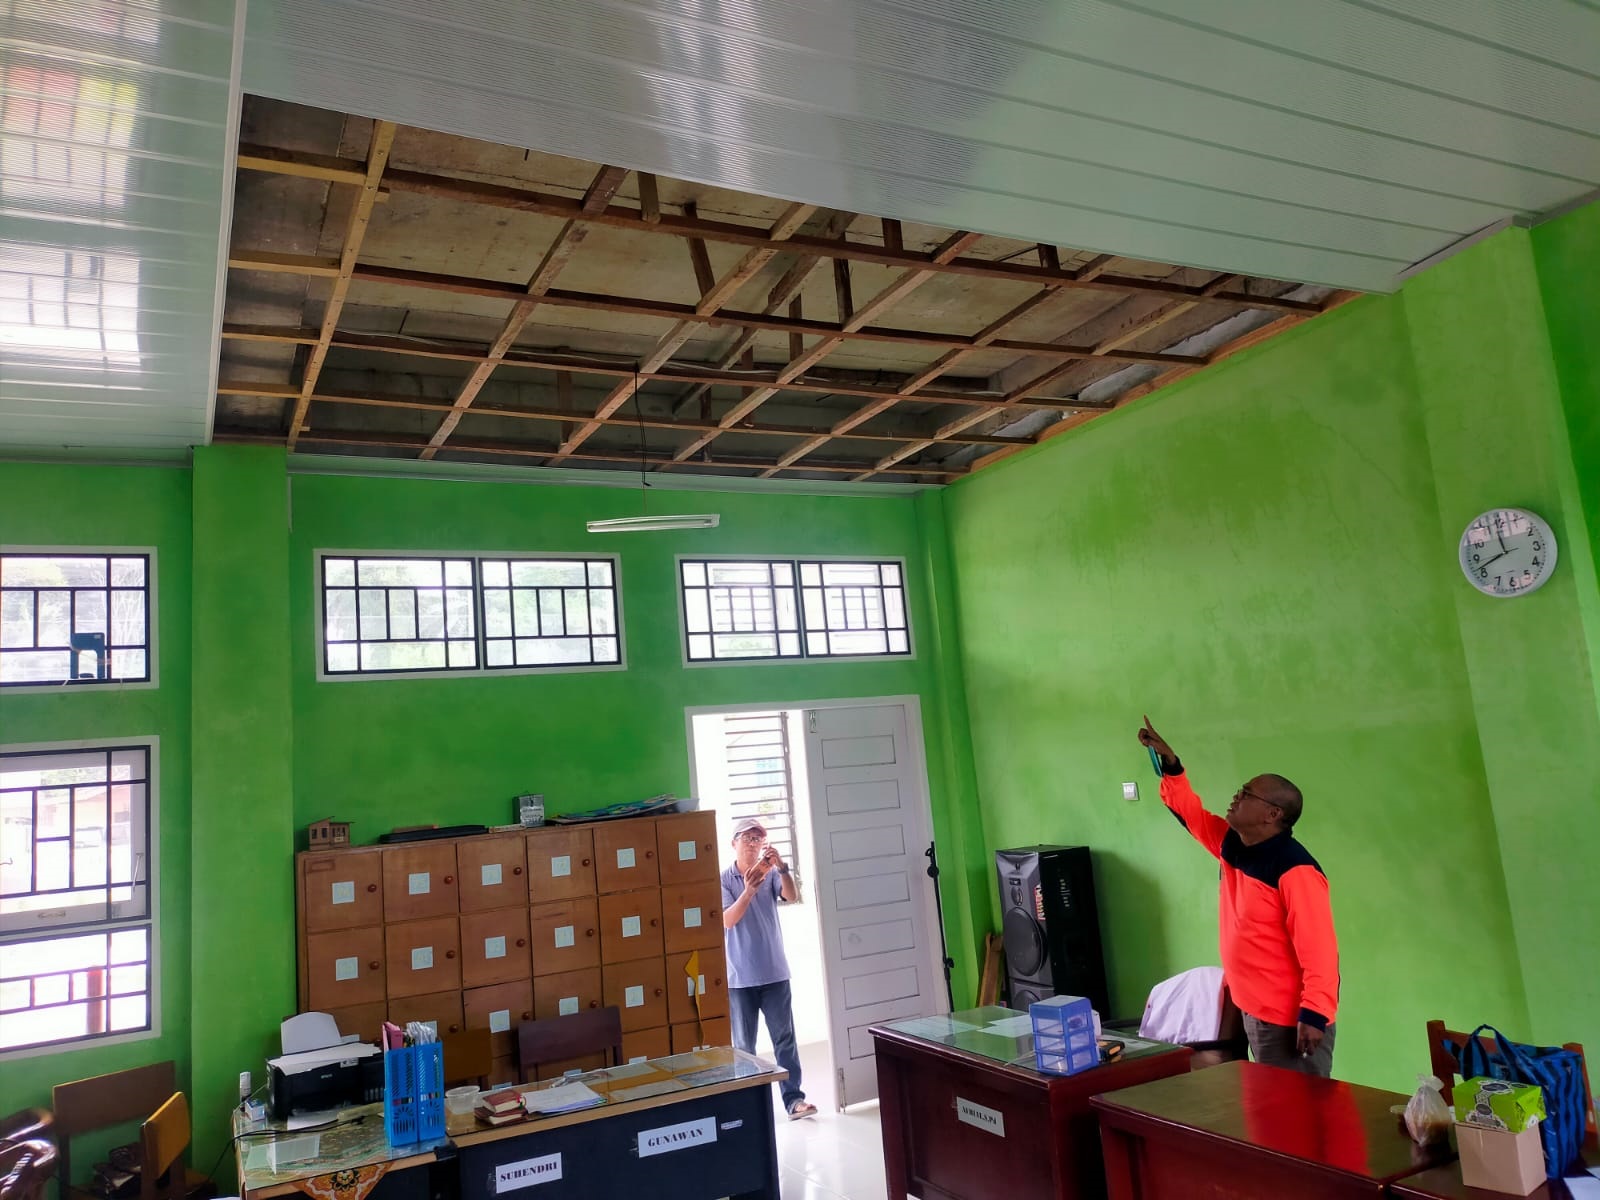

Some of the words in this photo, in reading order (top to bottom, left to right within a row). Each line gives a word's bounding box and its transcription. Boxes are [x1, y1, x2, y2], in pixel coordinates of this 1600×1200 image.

[1527, 527, 1535, 536] 2
[1474, 539, 1485, 550] 10
[1532, 540, 1541, 551] 3
[1473, 554, 1480, 564] 9
[1532, 555, 1541, 567] 4
[1481, 567, 1488, 578] 8
[1523, 569, 1531, 581] 5
[1494, 575, 1501, 586] 7
[1509, 576, 1517, 587] 6
[648, 1128, 704, 1148] GUNAWAN
[500, 1161, 558, 1183] SUHENDRI
